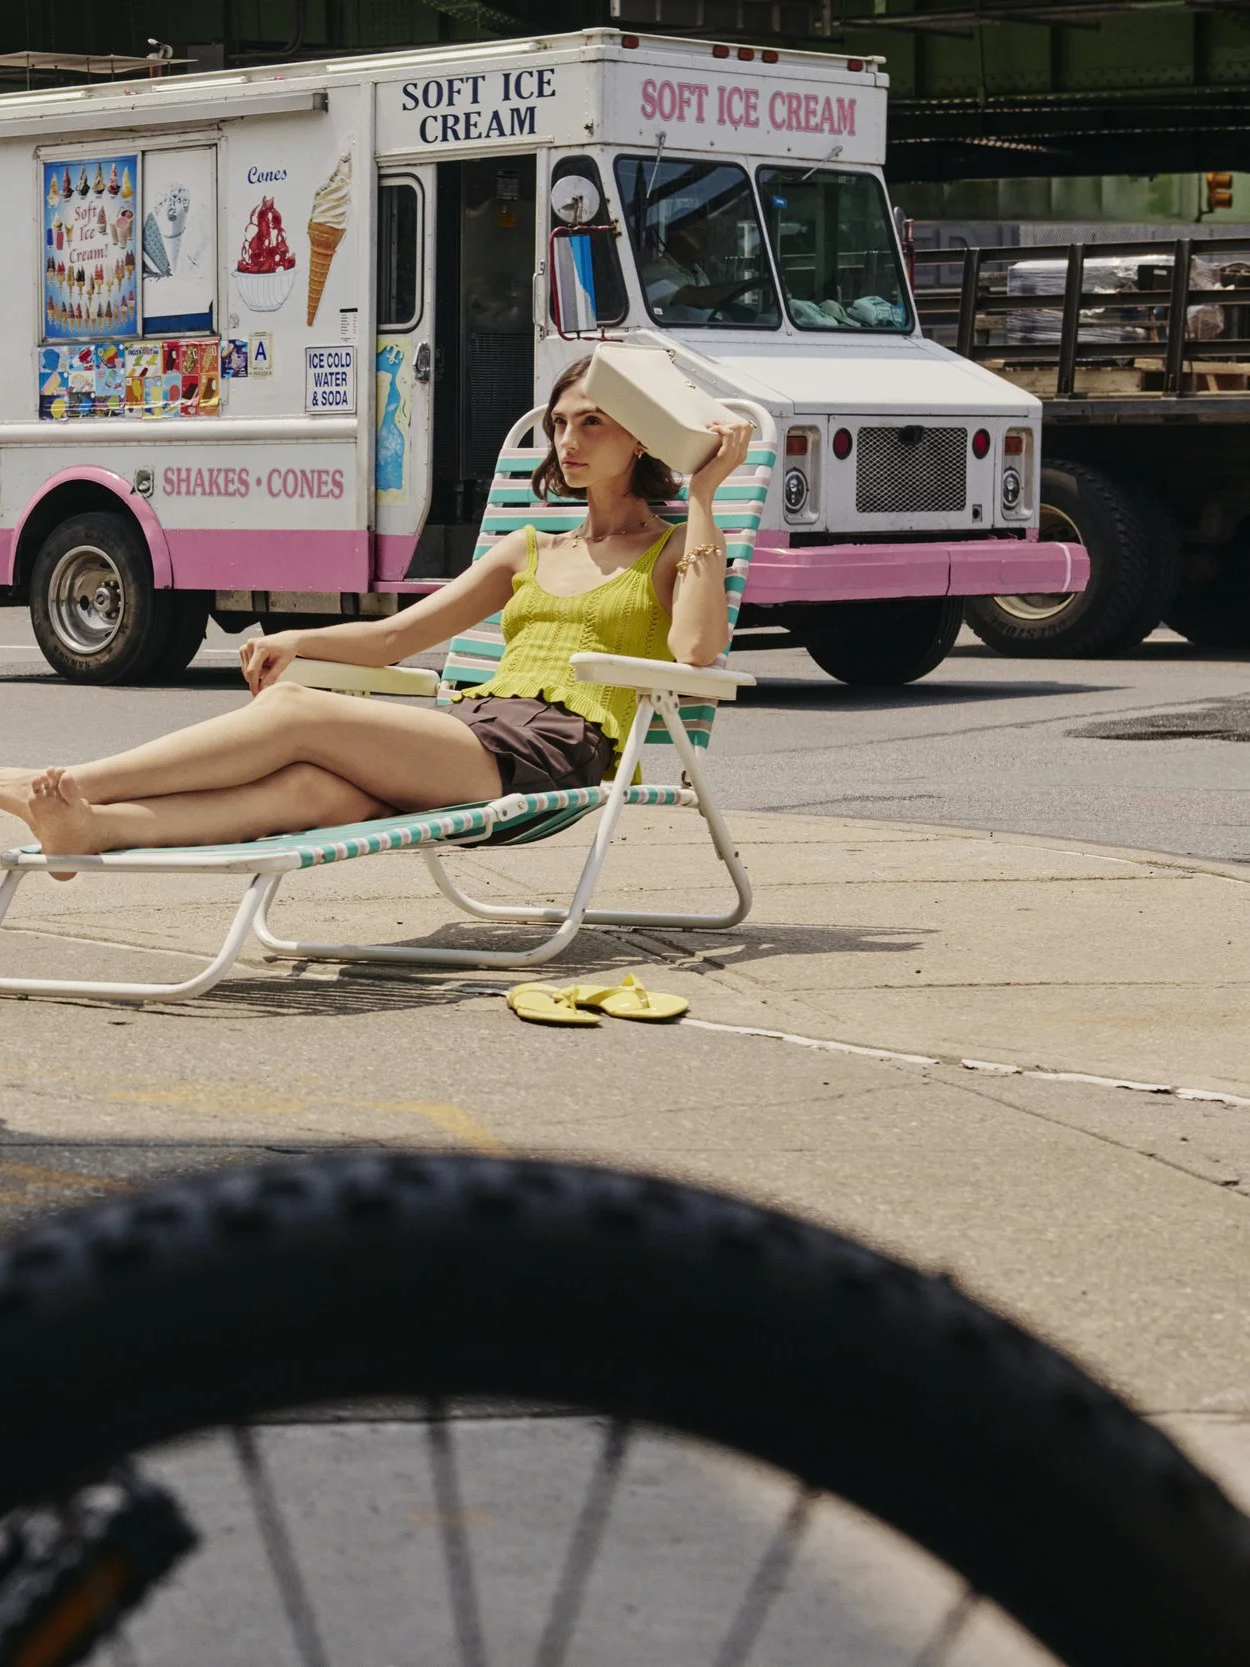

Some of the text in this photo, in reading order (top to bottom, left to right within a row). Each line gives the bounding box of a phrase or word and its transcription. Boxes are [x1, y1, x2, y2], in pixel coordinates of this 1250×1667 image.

[402, 68, 556, 111] SOFT ICE
[641, 78, 857, 137] SOFT ICE CREAM
[419, 106, 537, 144] CREAM
[247, 166, 287, 184] Cones
[74, 201, 97, 227] Soft
[79, 227, 95, 241] Ice
[69, 244, 108, 264] Cream!
[254, 341, 267, 361] A
[309, 352, 352, 369] ICE COLD
[313, 371, 347, 387] WATER
[312, 390, 348, 406] & SODA
[163, 466, 344, 499] SHAKES CONES
